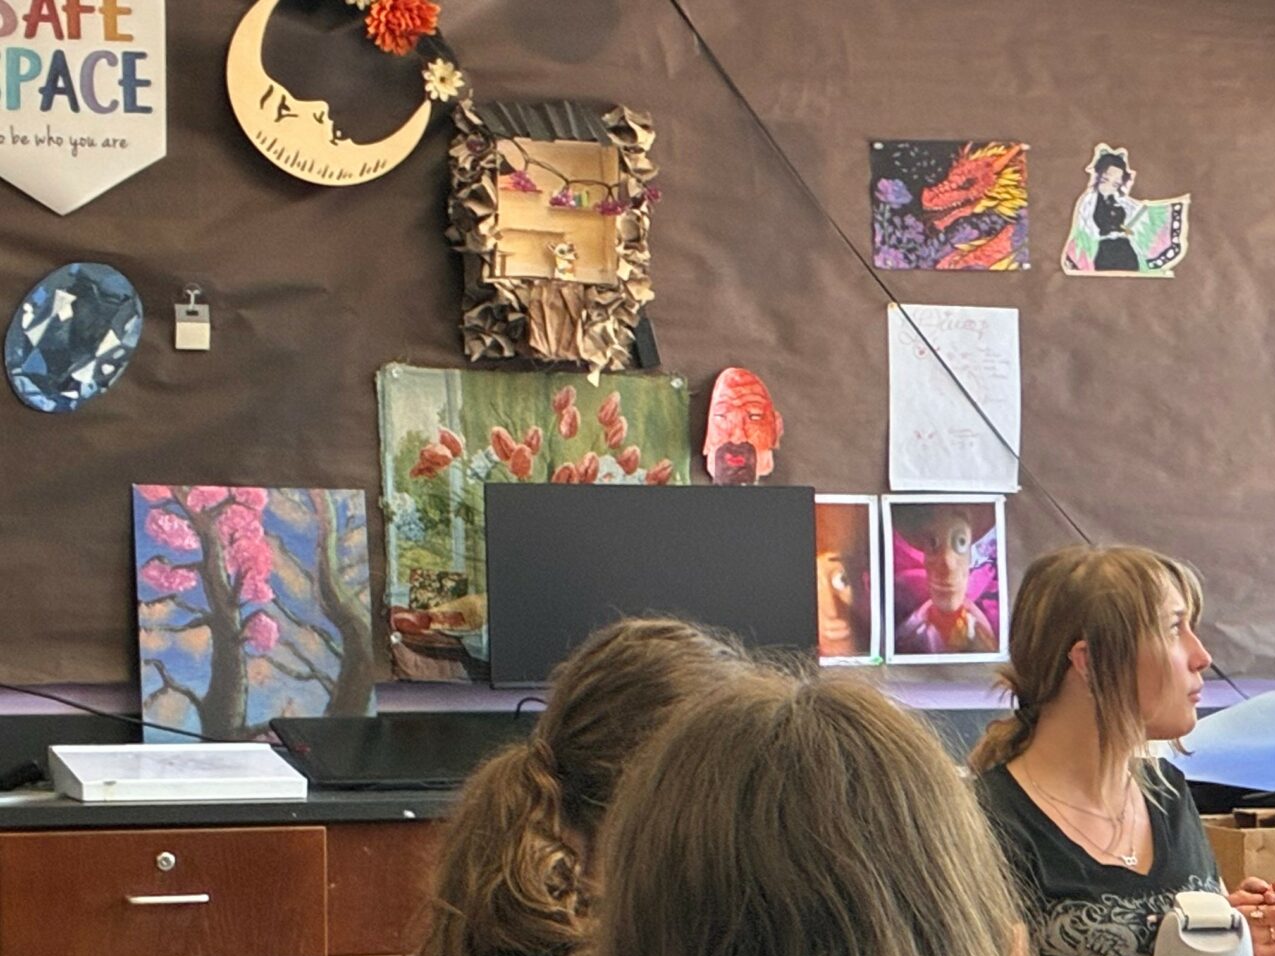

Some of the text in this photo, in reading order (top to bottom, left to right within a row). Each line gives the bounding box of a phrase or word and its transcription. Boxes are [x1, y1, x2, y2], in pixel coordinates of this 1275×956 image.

[0, 46, 154, 115] PACE
[9, 124, 30, 146] be
[34, 124, 64, 147] who
[69, 135, 97, 158] you
[101, 137, 129, 149] are
